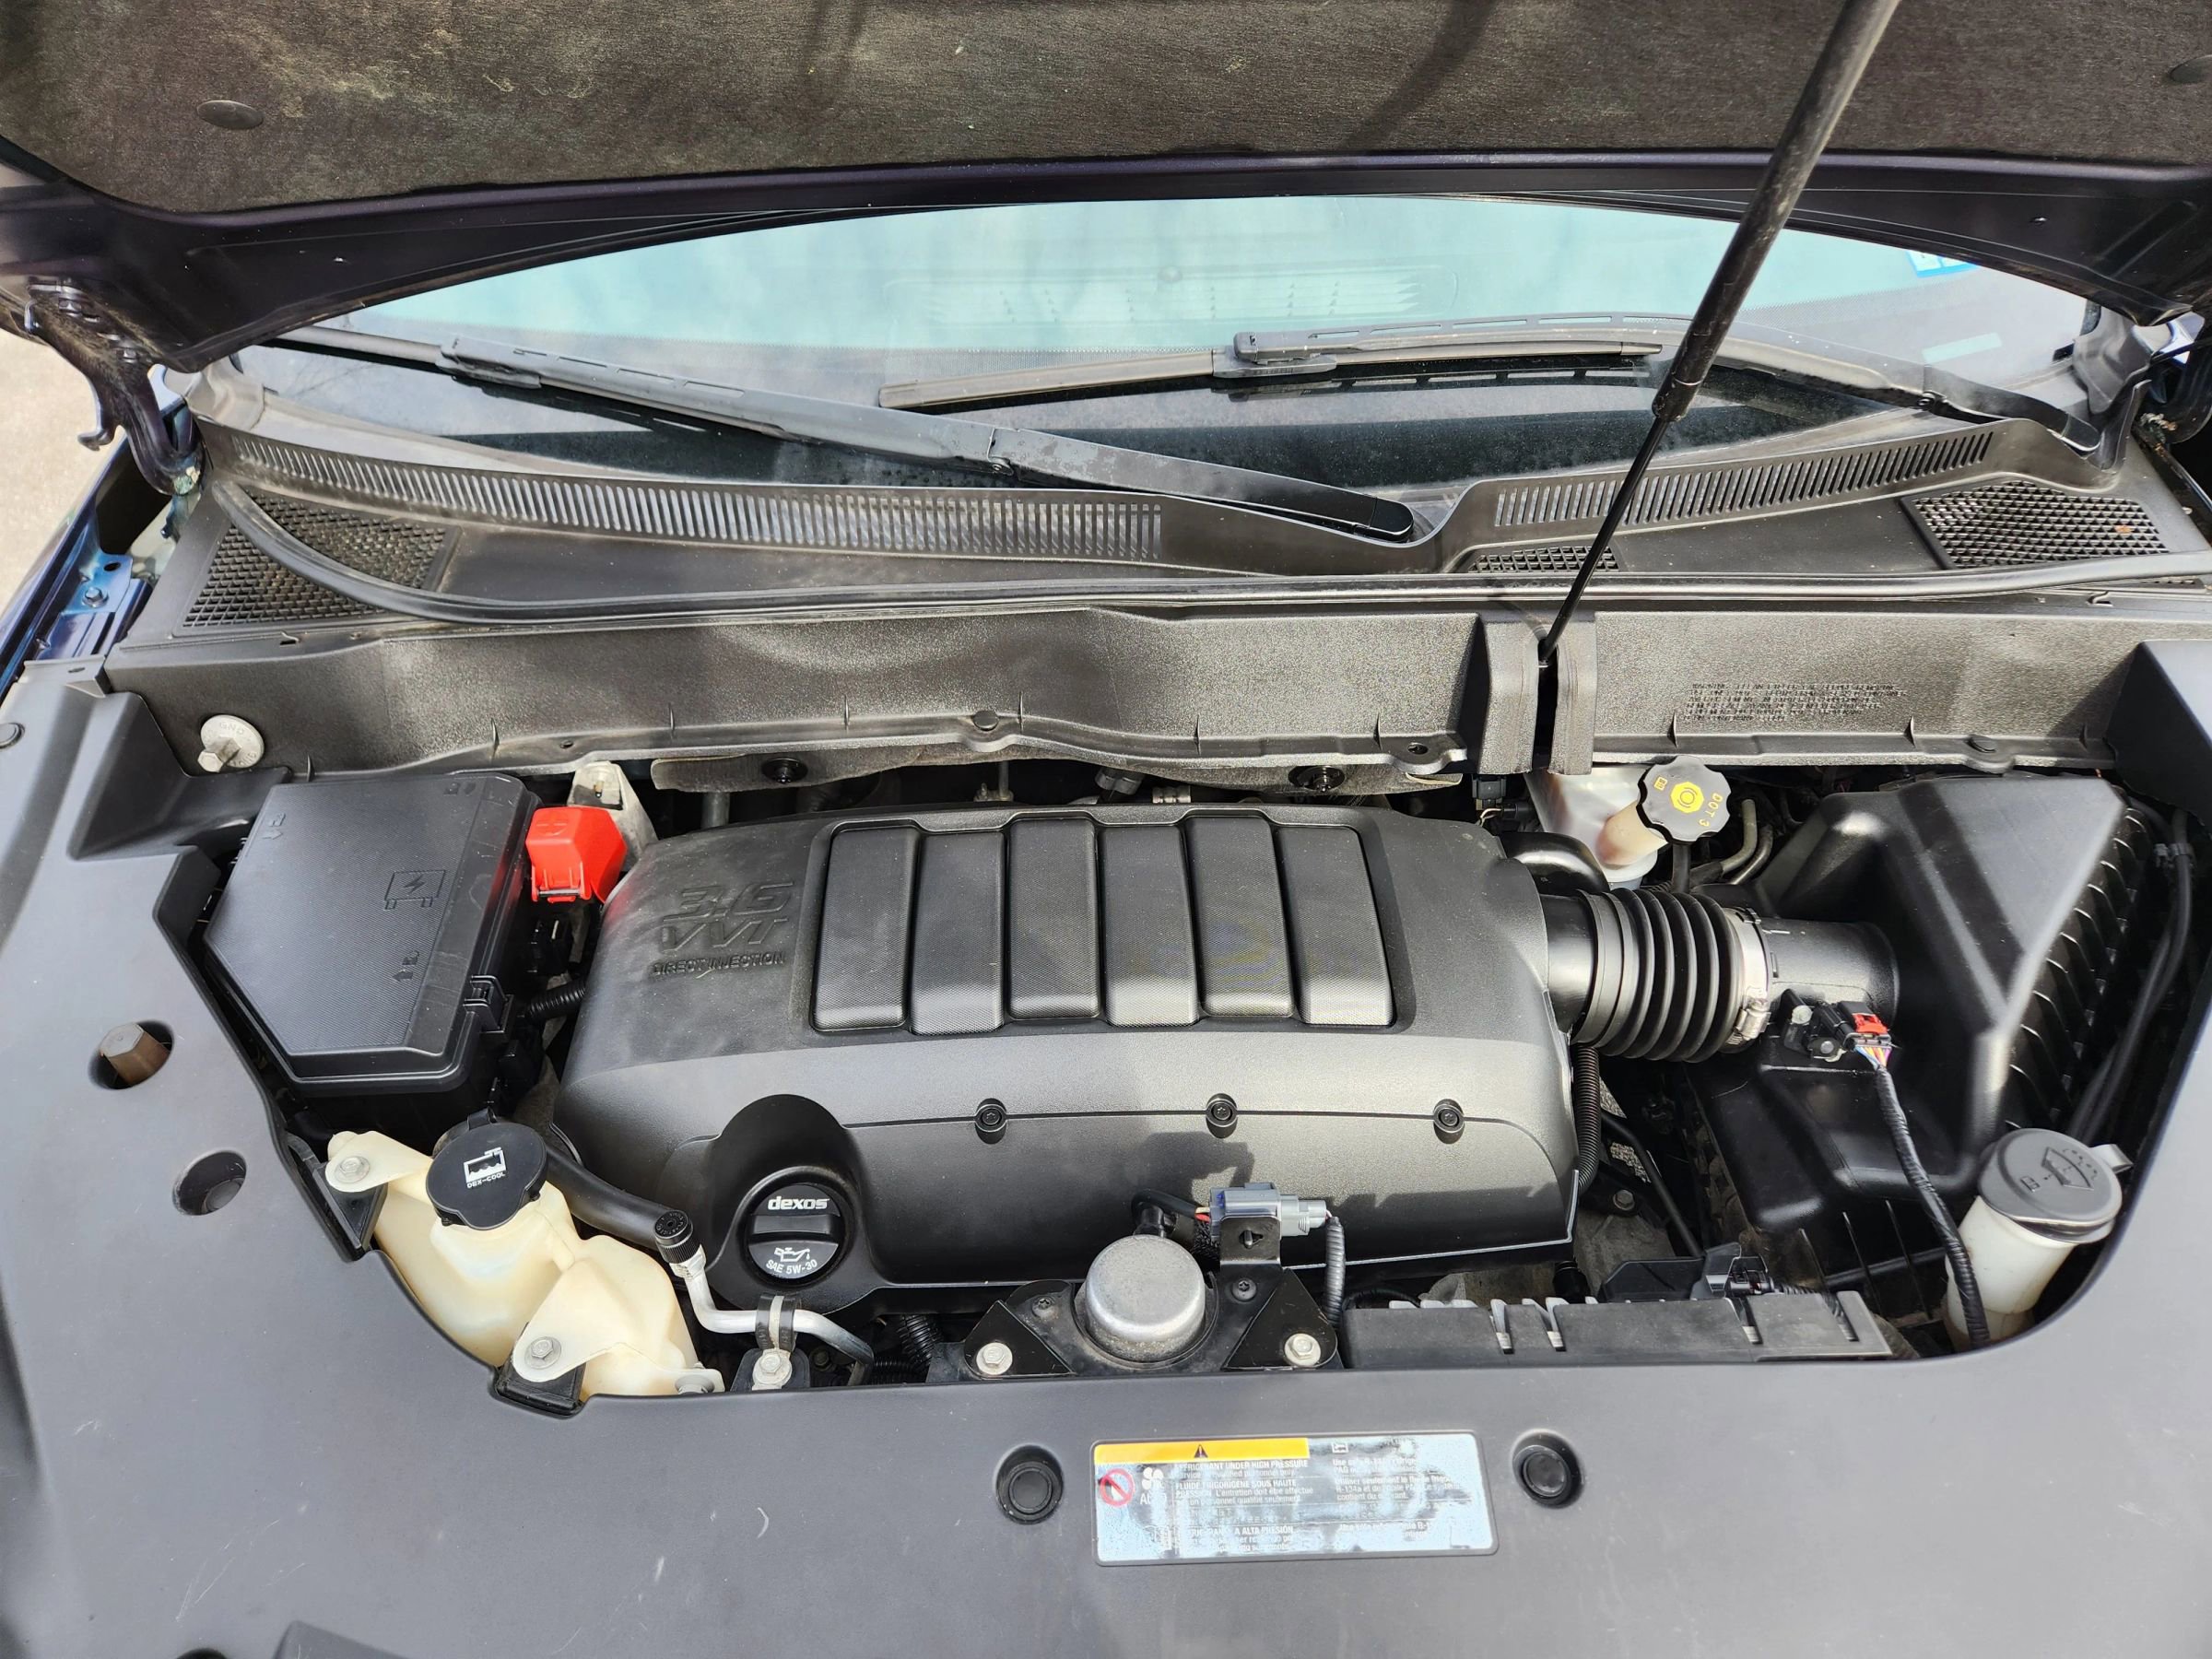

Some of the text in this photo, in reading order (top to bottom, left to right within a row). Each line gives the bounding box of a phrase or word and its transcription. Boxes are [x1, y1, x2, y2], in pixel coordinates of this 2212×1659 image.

[1699, 793, 1724, 827] DOT 3
[660, 920, 790, 953] VVT
[652, 951, 784, 977] DIRECT INJECTION
[466, 1171, 506, 1189] DEX-COOL
[767, 1195, 830, 1211] dexos
[765, 1259, 818, 1275] SAE 5W-30
[1225, 1462, 1250, 1471] UNDER
[1252, 1461, 1270, 1470] HIGH
[1270, 1459, 1309, 1469] PRESSURE
[1273, 1479, 1297, 1488] HAUTE
[1242, 1527, 1261, 1535] ALTA
